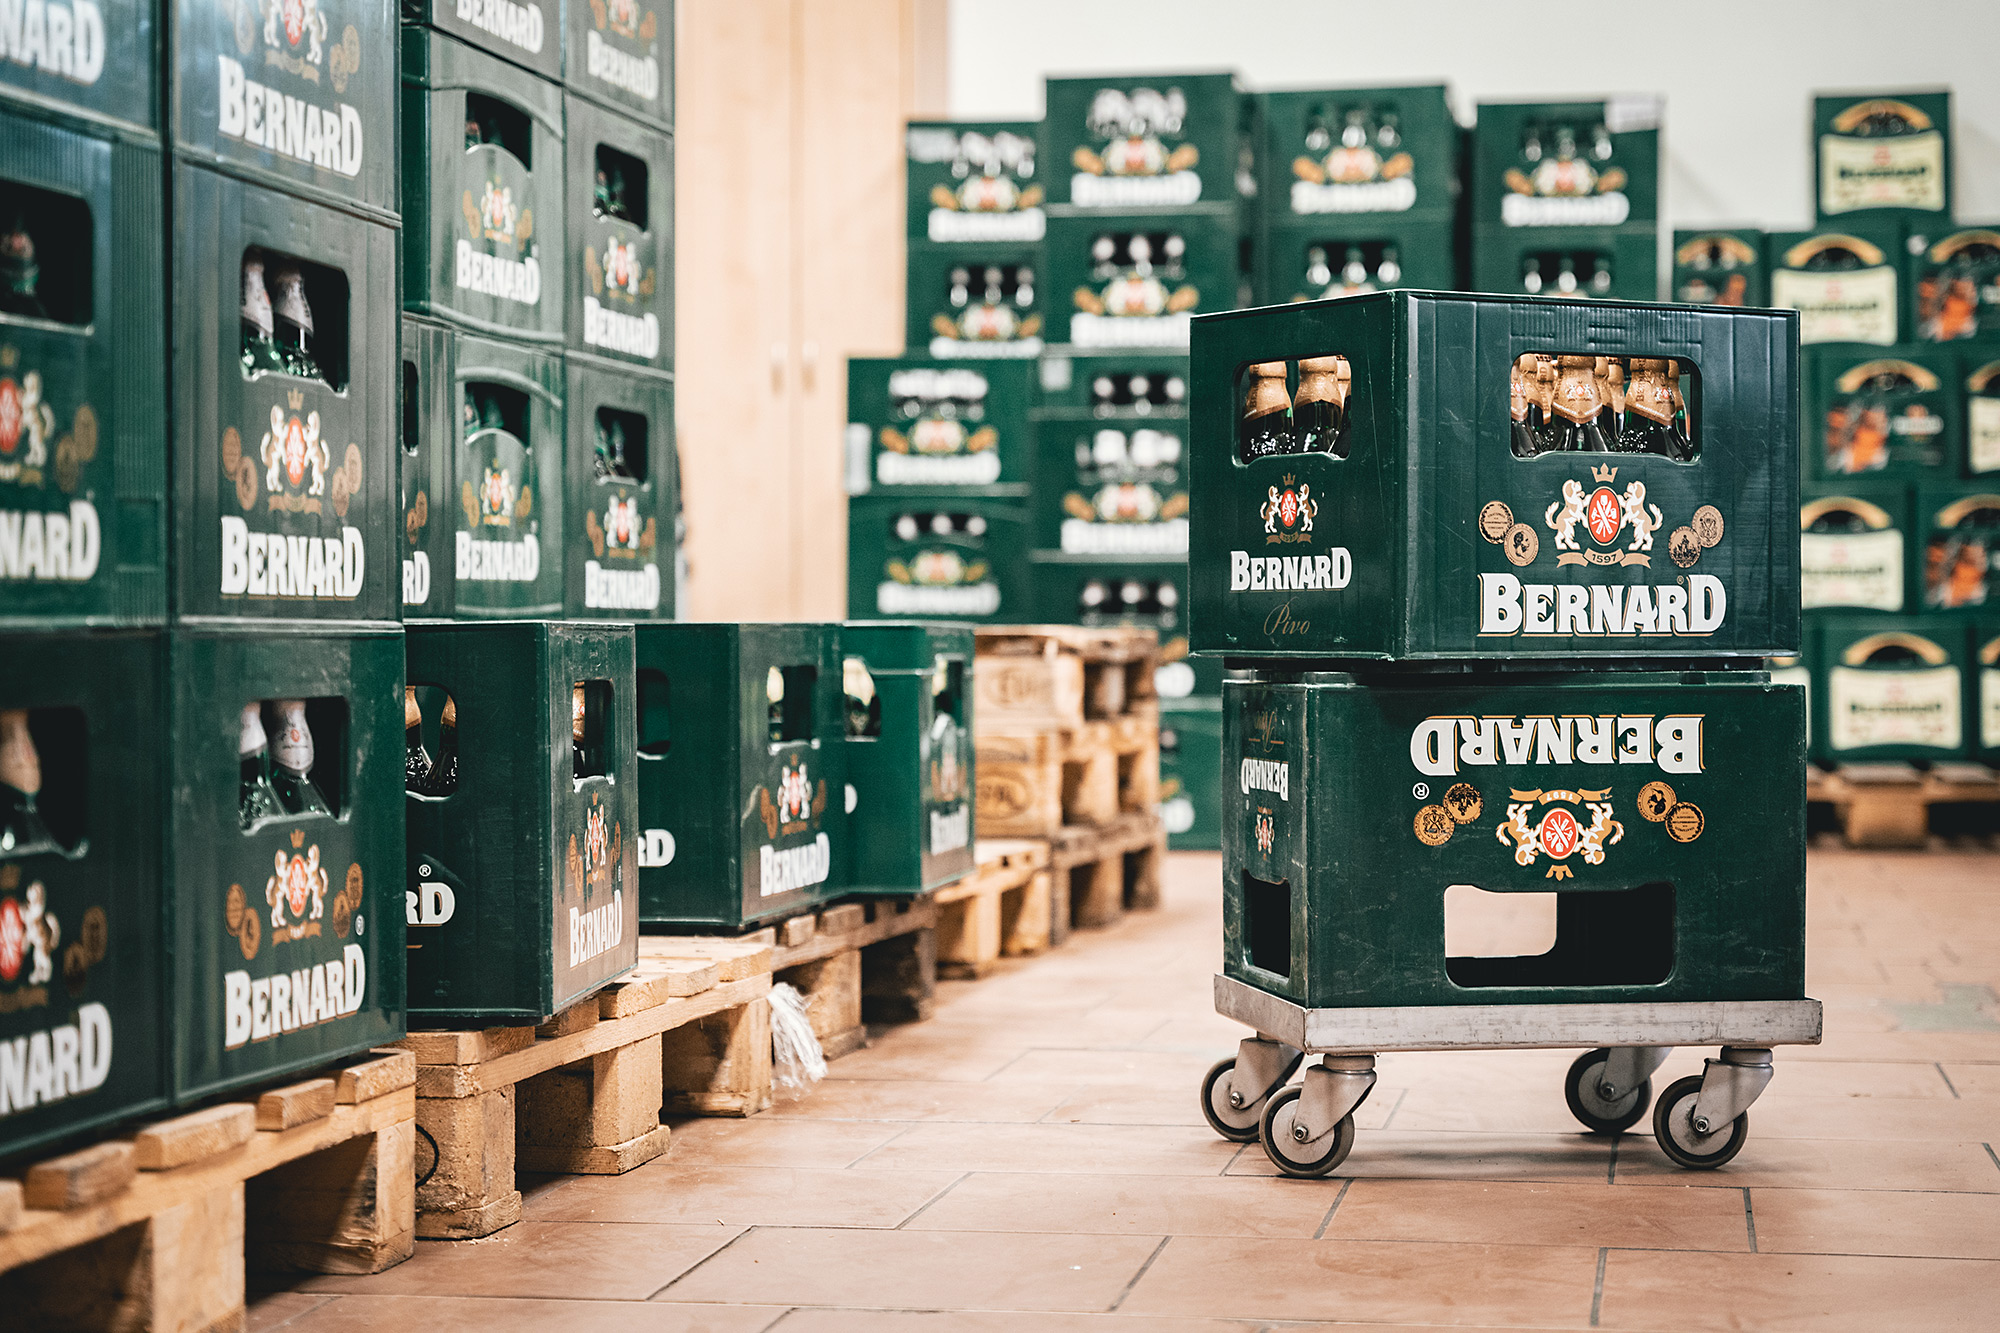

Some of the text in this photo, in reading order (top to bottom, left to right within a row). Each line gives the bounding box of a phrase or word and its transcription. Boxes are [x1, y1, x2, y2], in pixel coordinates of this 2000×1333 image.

[217, 54, 363, 177] BERNARD
[457, 238, 541, 305] BERNARD
[221, 516, 364, 597] BERNARD
[456, 530, 540, 582] BERNARD
[1230, 547, 1352, 591] BERNARD
[1591, 552, 1618, 565] 1597
[1263, 596, 1311, 636] Pivo
[1477, 572, 1727, 637] BERNARD
[1410, 715, 1705, 776] BERNARD
[1241, 757, 1288, 801] BERNARD
[1546, 790, 1574, 802] 1597
[760, 832, 830, 897] BERNARD
[569, 889, 622, 968] BERNARD
[225, 943, 366, 1048] BERNARD
